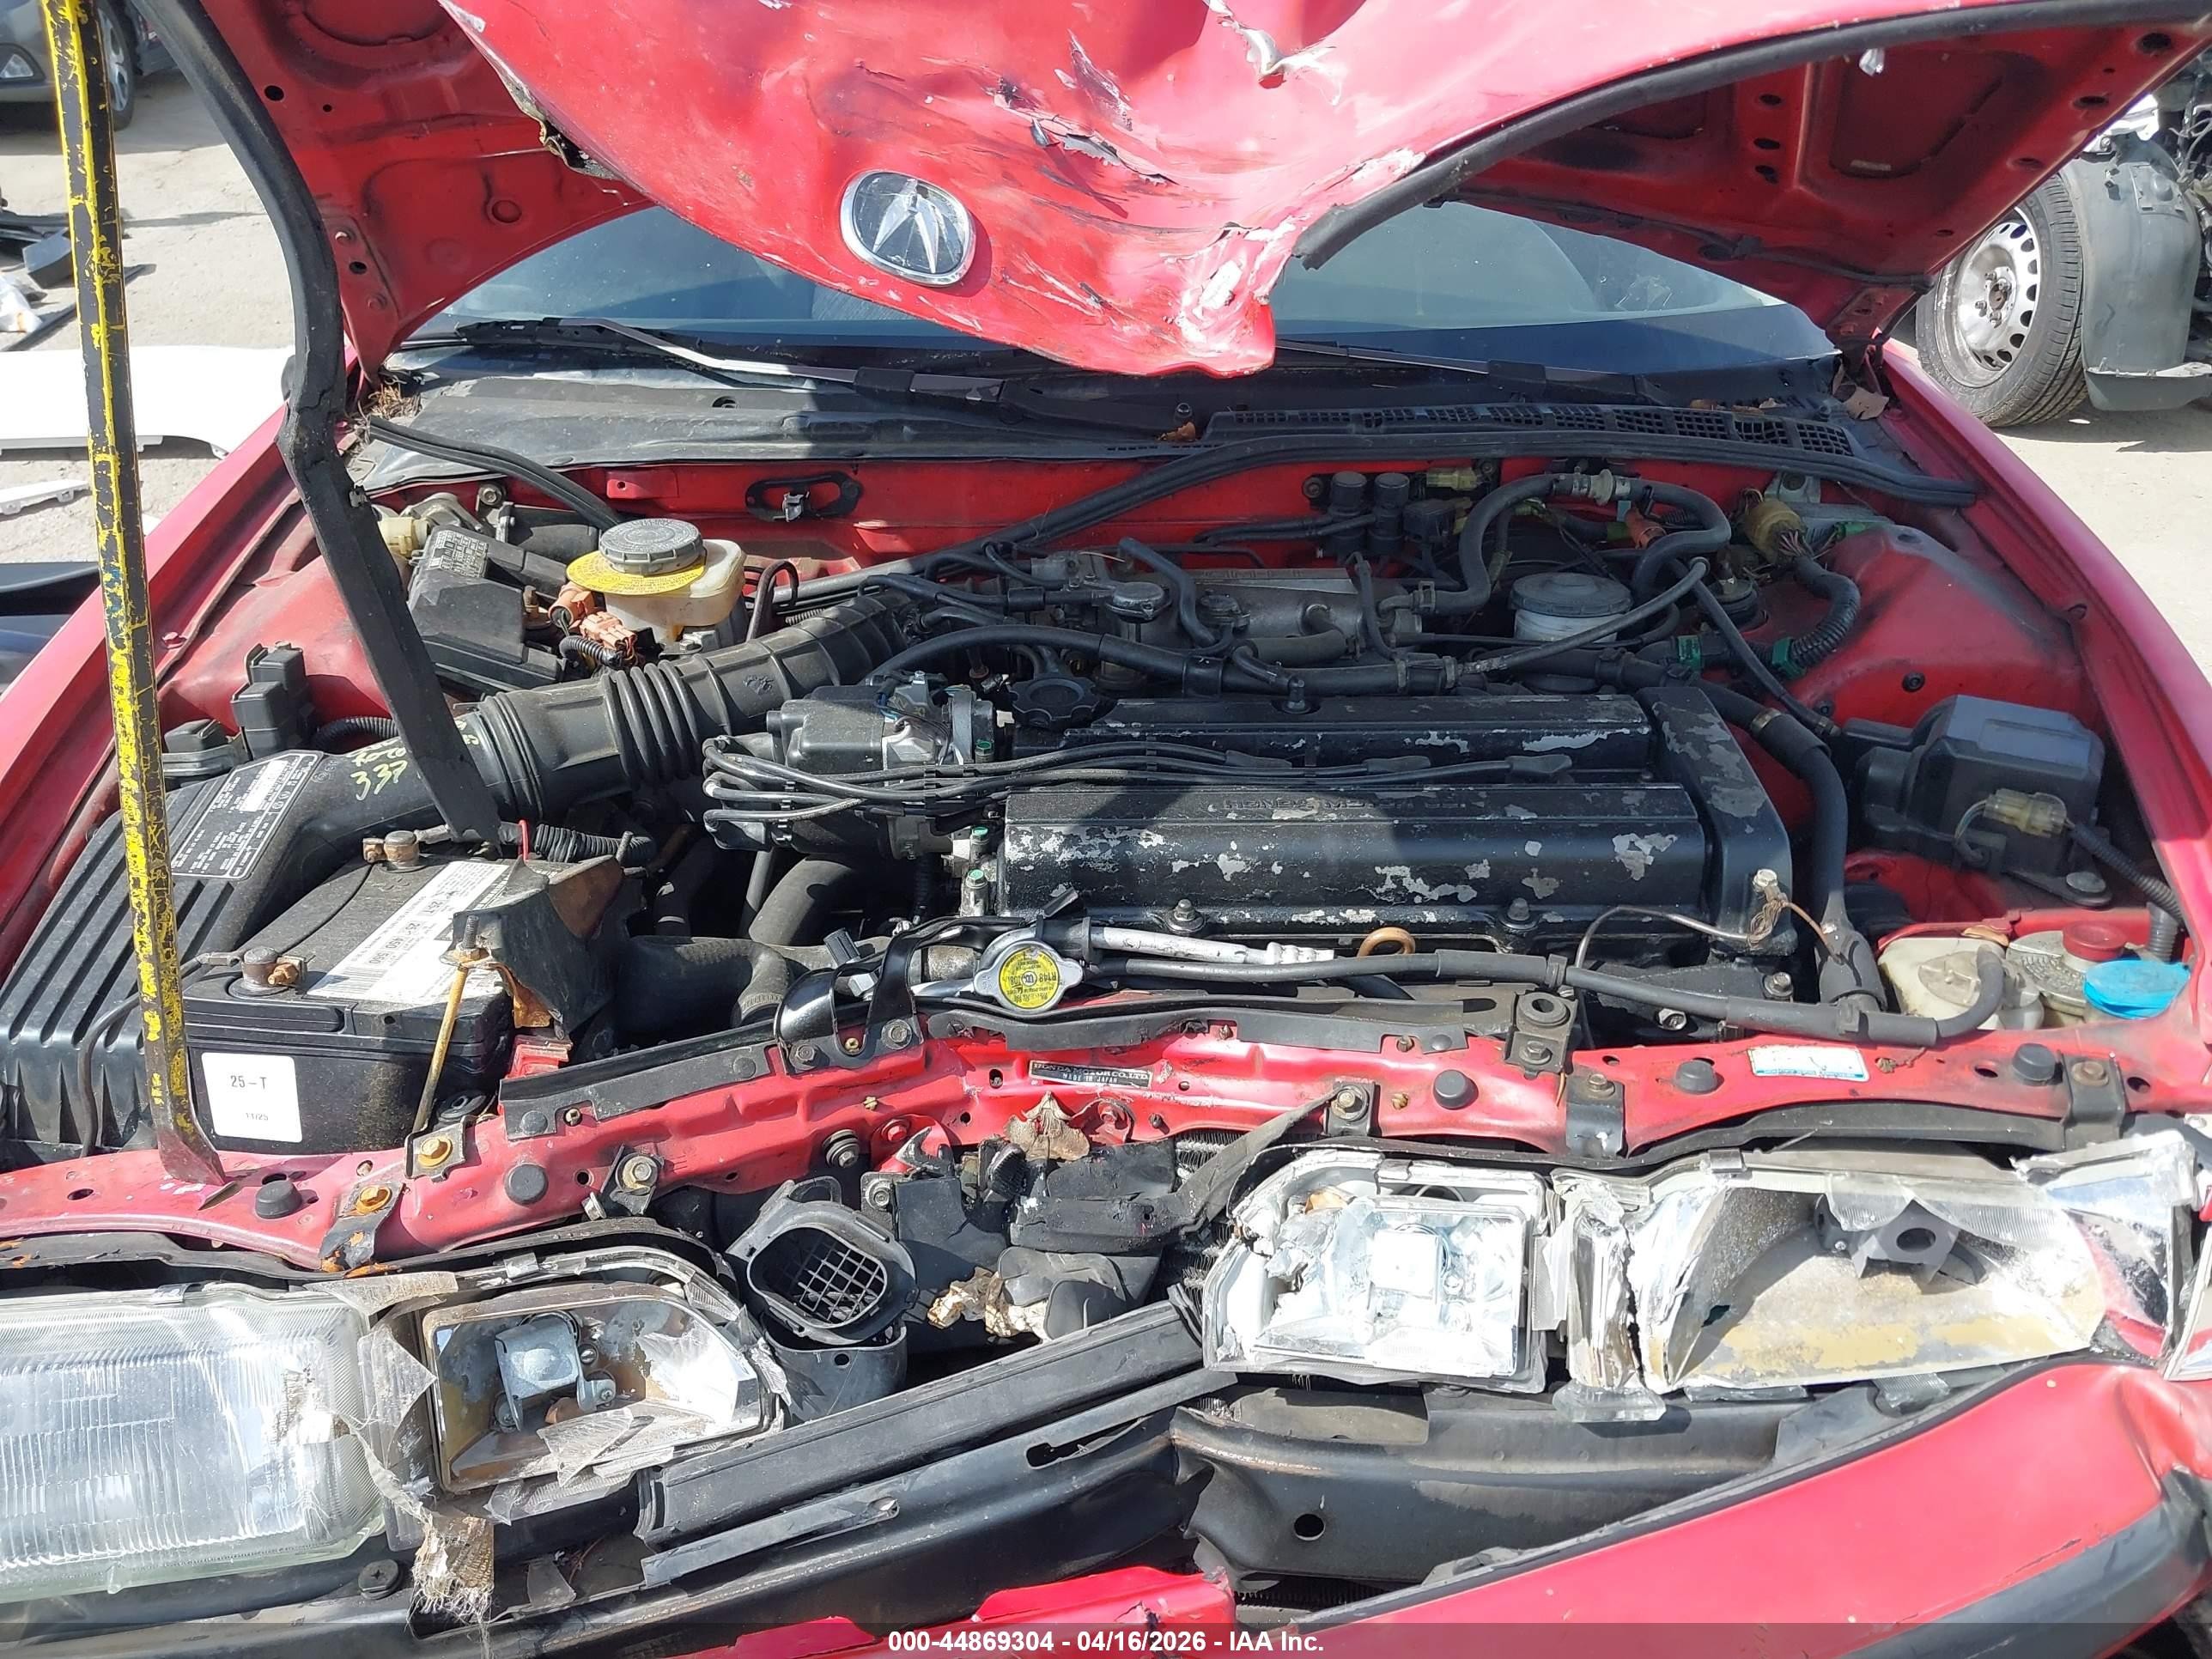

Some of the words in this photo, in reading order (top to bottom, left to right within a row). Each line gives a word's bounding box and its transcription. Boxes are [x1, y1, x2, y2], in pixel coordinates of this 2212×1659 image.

[1033, 1063, 1072, 1073] HONDA
[1062, 1073, 1081, 1082] MADE
[1097, 1075, 1118, 1085] JAPAN
